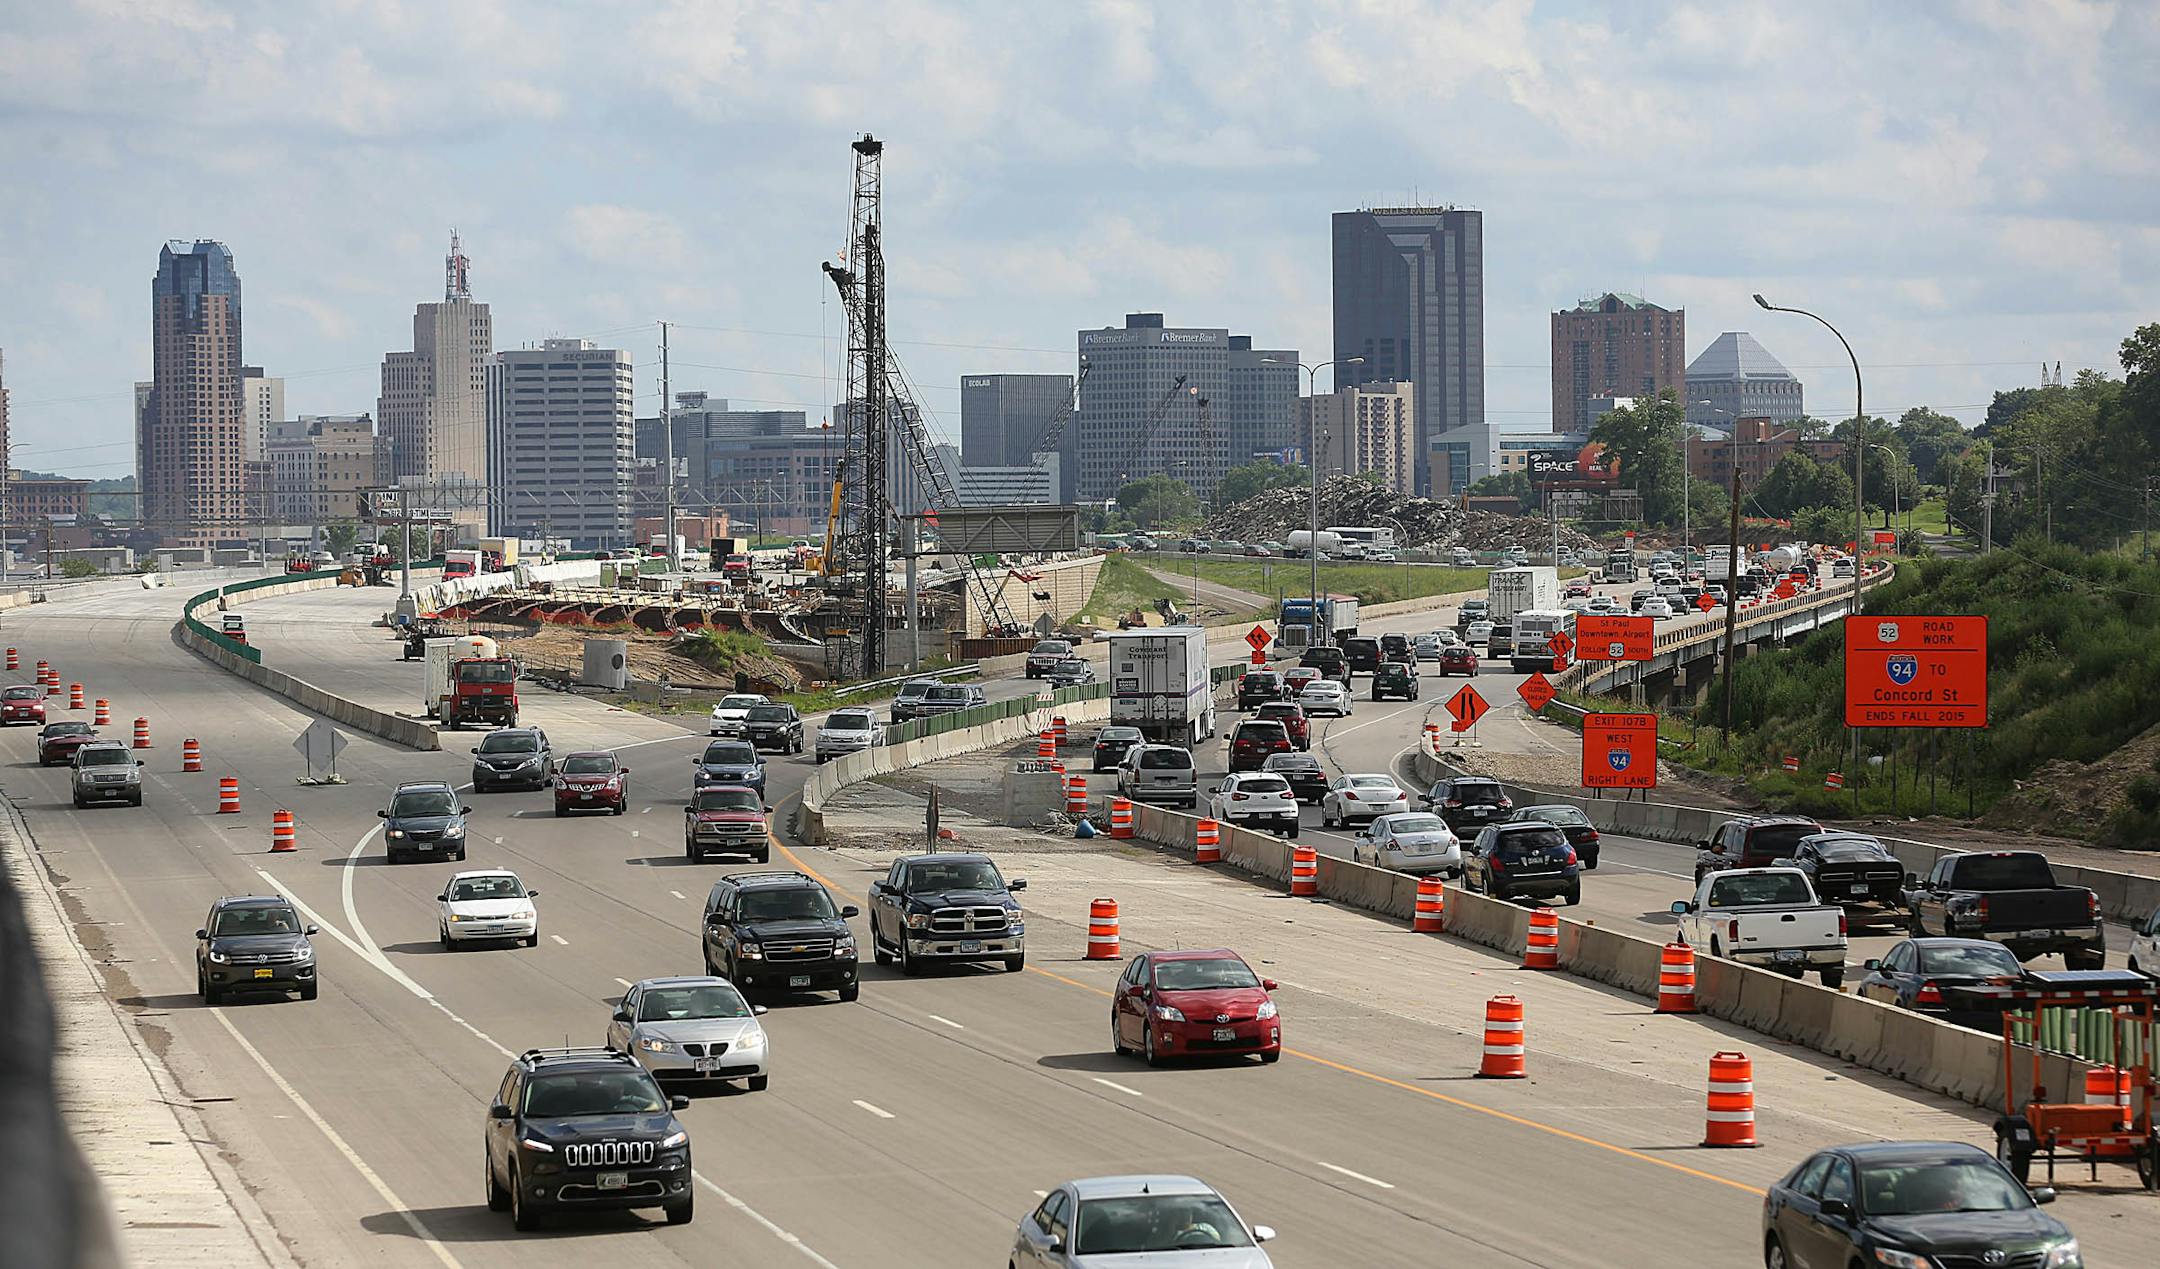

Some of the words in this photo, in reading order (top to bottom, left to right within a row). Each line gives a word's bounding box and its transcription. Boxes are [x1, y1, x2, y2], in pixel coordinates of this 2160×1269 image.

[1373, 208, 1409, 216] WELLS
[563, 353, 612, 361] SECURIAN
[1534, 460, 1577, 472] SPACE
[1600, 620, 1608, 628] St
[1612, 620, 1630, 628] Paul
[1923, 622, 1954, 632] ROAD
[1580, 630, 1619, 638] Downtown
[1622, 630, 1650, 639] Airport
[1881, 628, 1896, 638] 52
[1923, 634, 1955, 644] WORK
[1610, 646, 1622, 654] 52
[1892, 663, 1912, 678] 94
[1929, 664, 1946, 675] TO
[1874, 689, 1933, 702] Concord
[1943, 689, 1958, 702] St
[1866, 711, 1895, 721] ENDS
[1902, 711, 1930, 721] FALL
[1938, 711, 1965, 721] 2015
[1595, 717, 1616, 726] EXIT
[1623, 717, 1647, 726] 107B
[1606, 734, 1633, 743] WEST
[1612, 756, 1627, 766] 94
[1588, 775, 1617, 785] RIGHT
[1624, 776, 1650, 785] LANE
